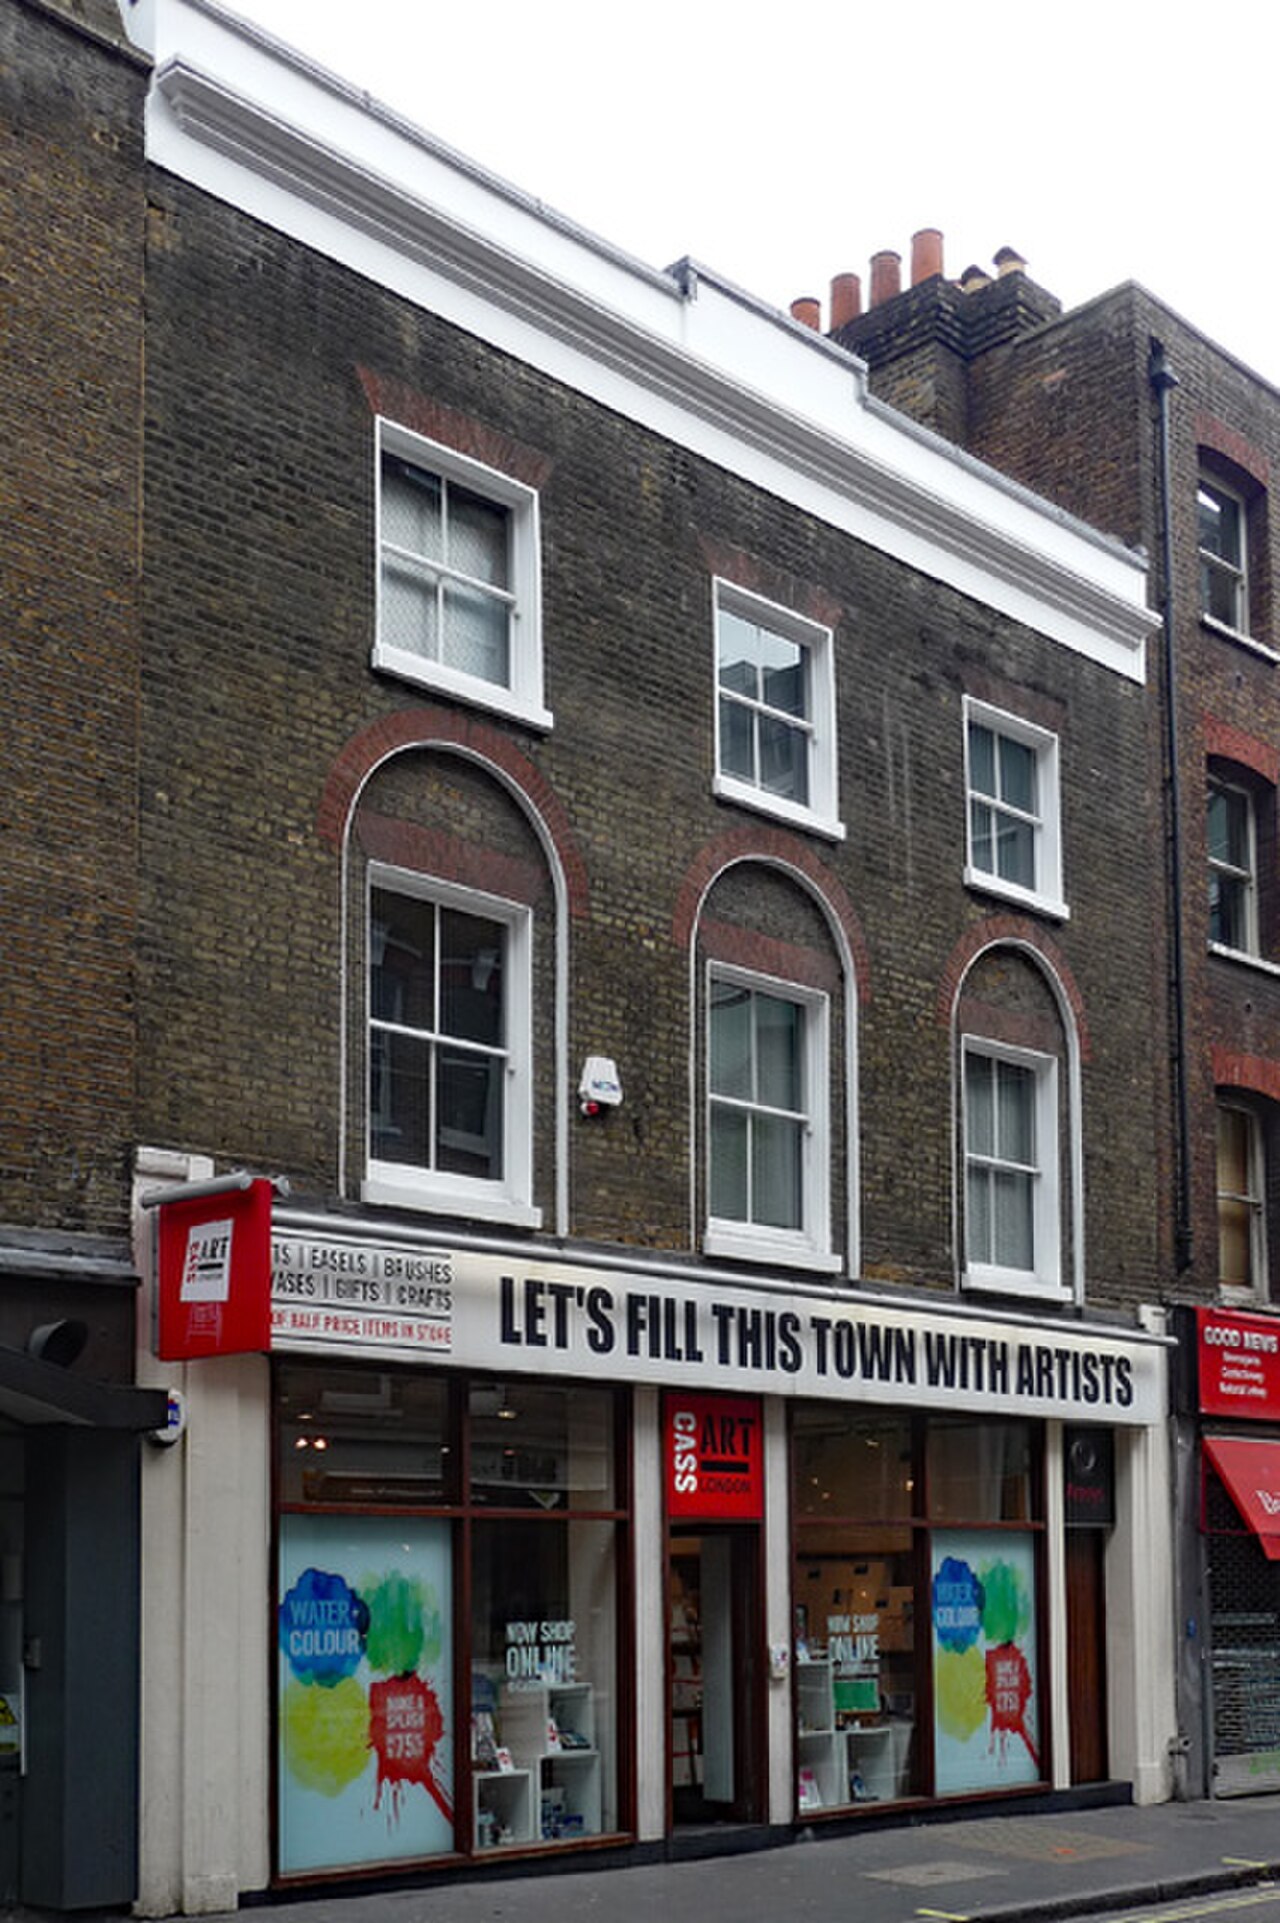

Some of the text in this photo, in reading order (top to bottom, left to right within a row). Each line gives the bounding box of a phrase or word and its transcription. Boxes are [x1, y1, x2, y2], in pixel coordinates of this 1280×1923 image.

[312, 1249, 366, 1274] EASELS
[384, 1257, 452, 1285] BRUSHES
[336, 1278, 380, 1301] GIFTS
[397, 1285, 452, 1312] CRAFTS
[291, 1313, 320, 1329] HALF
[324, 1315, 360, 1335] PRICE
[362, 1318, 398, 1338] ITEMS
[400, 1323, 415, 1339] IN
[417, 1324, 452, 1345] STORE
[500, 1276, 1134, 1408] LET'S FILL THIS TOWN WITH ARTISTS
[1203, 1325, 1278, 1354] GOOD NEWS
[673, 1410, 698, 1494] CASS
[701, 1414, 754, 1457] ART
[701, 1478, 751, 1494] LONDON
[289, 1628, 360, 1656] COLOUR
[506, 1620, 576, 1643] NOW SHOP
[506, 1645, 576, 1683] ONLINE
